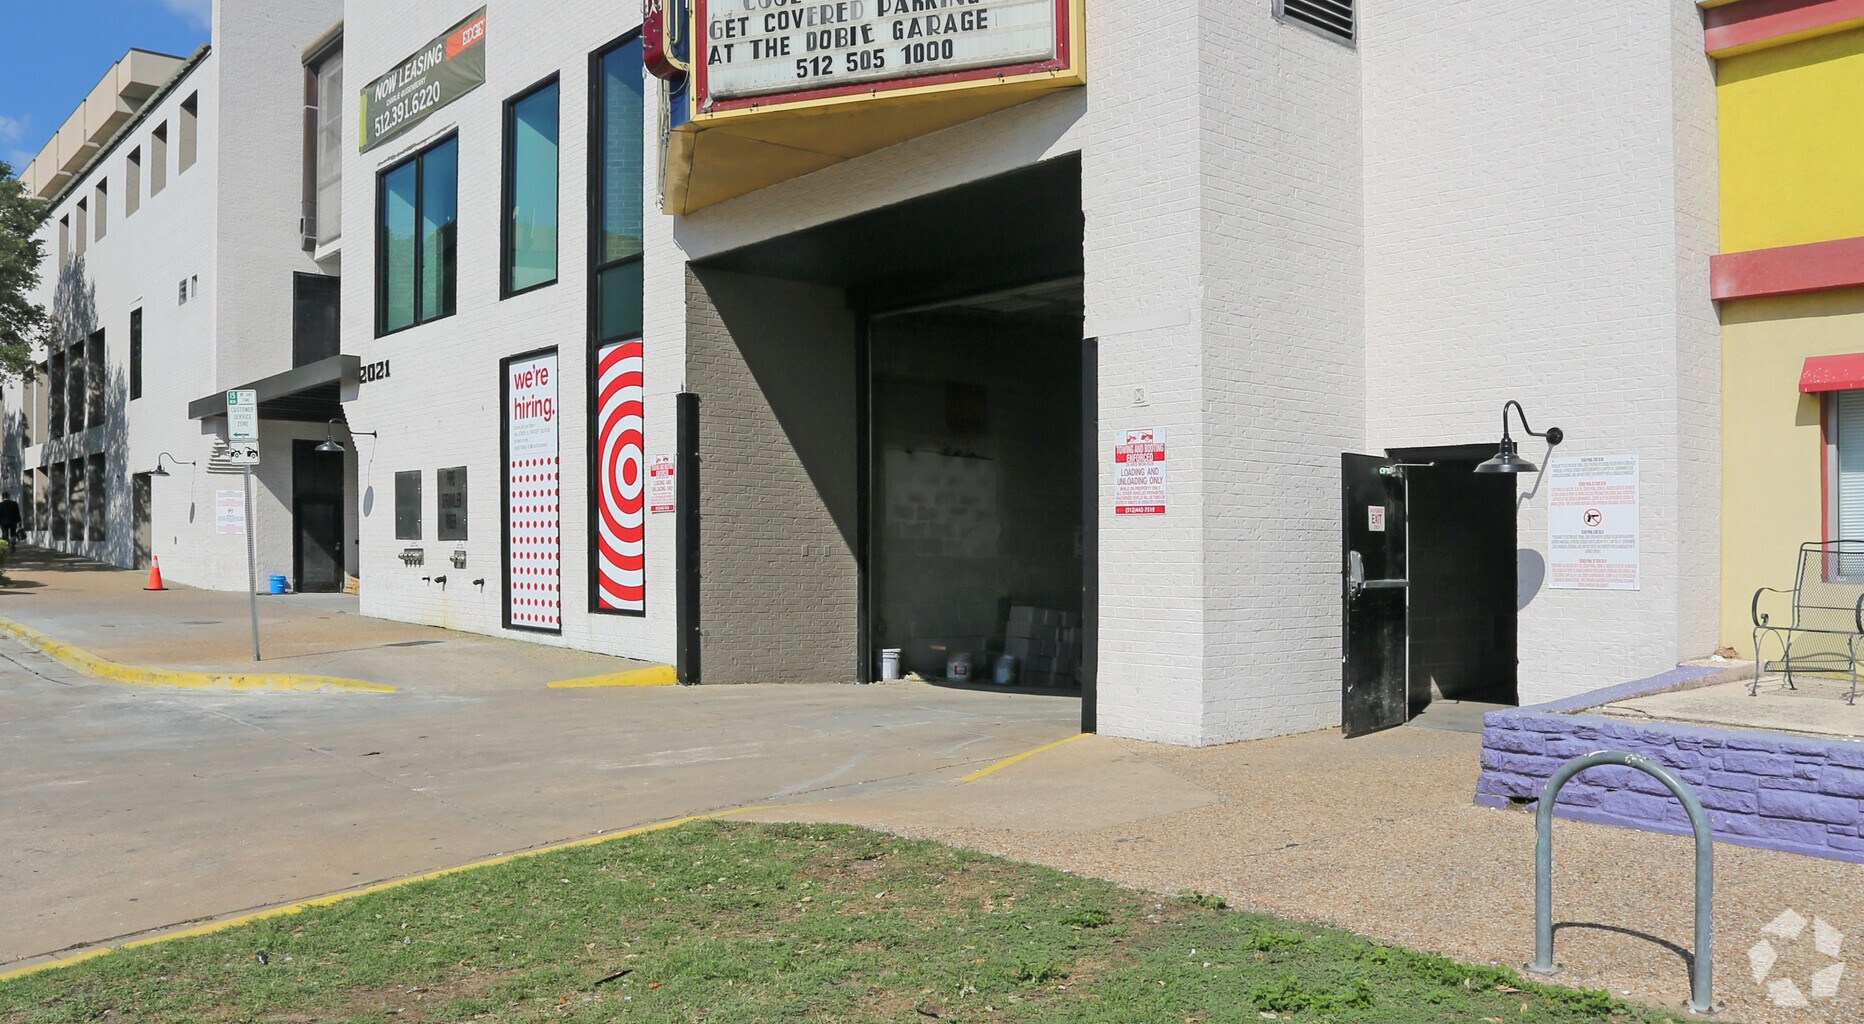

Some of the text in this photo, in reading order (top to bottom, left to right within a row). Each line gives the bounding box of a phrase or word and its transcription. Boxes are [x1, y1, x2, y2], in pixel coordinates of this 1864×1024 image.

[462, 20, 484, 46] EDGE
[709, 16, 749, 40] GET
[764, 0, 864, 33] COVERED
[707, 8, 988, 66] AT THE DOBIE GARAGE
[374, 43, 443, 103] NOW LEASING
[796, 39, 953, 79] 512 505 1000
[374, 80, 440, 137] 512.391.6220
[360, 360, 391, 384] 2021
[514, 394, 555, 422] hiring.
[1117, 476, 1164, 485] UNLOADING ONLY
[1121, 467, 1159, 477] LOADING AND
[1372, 514, 1382, 524] EXIT
